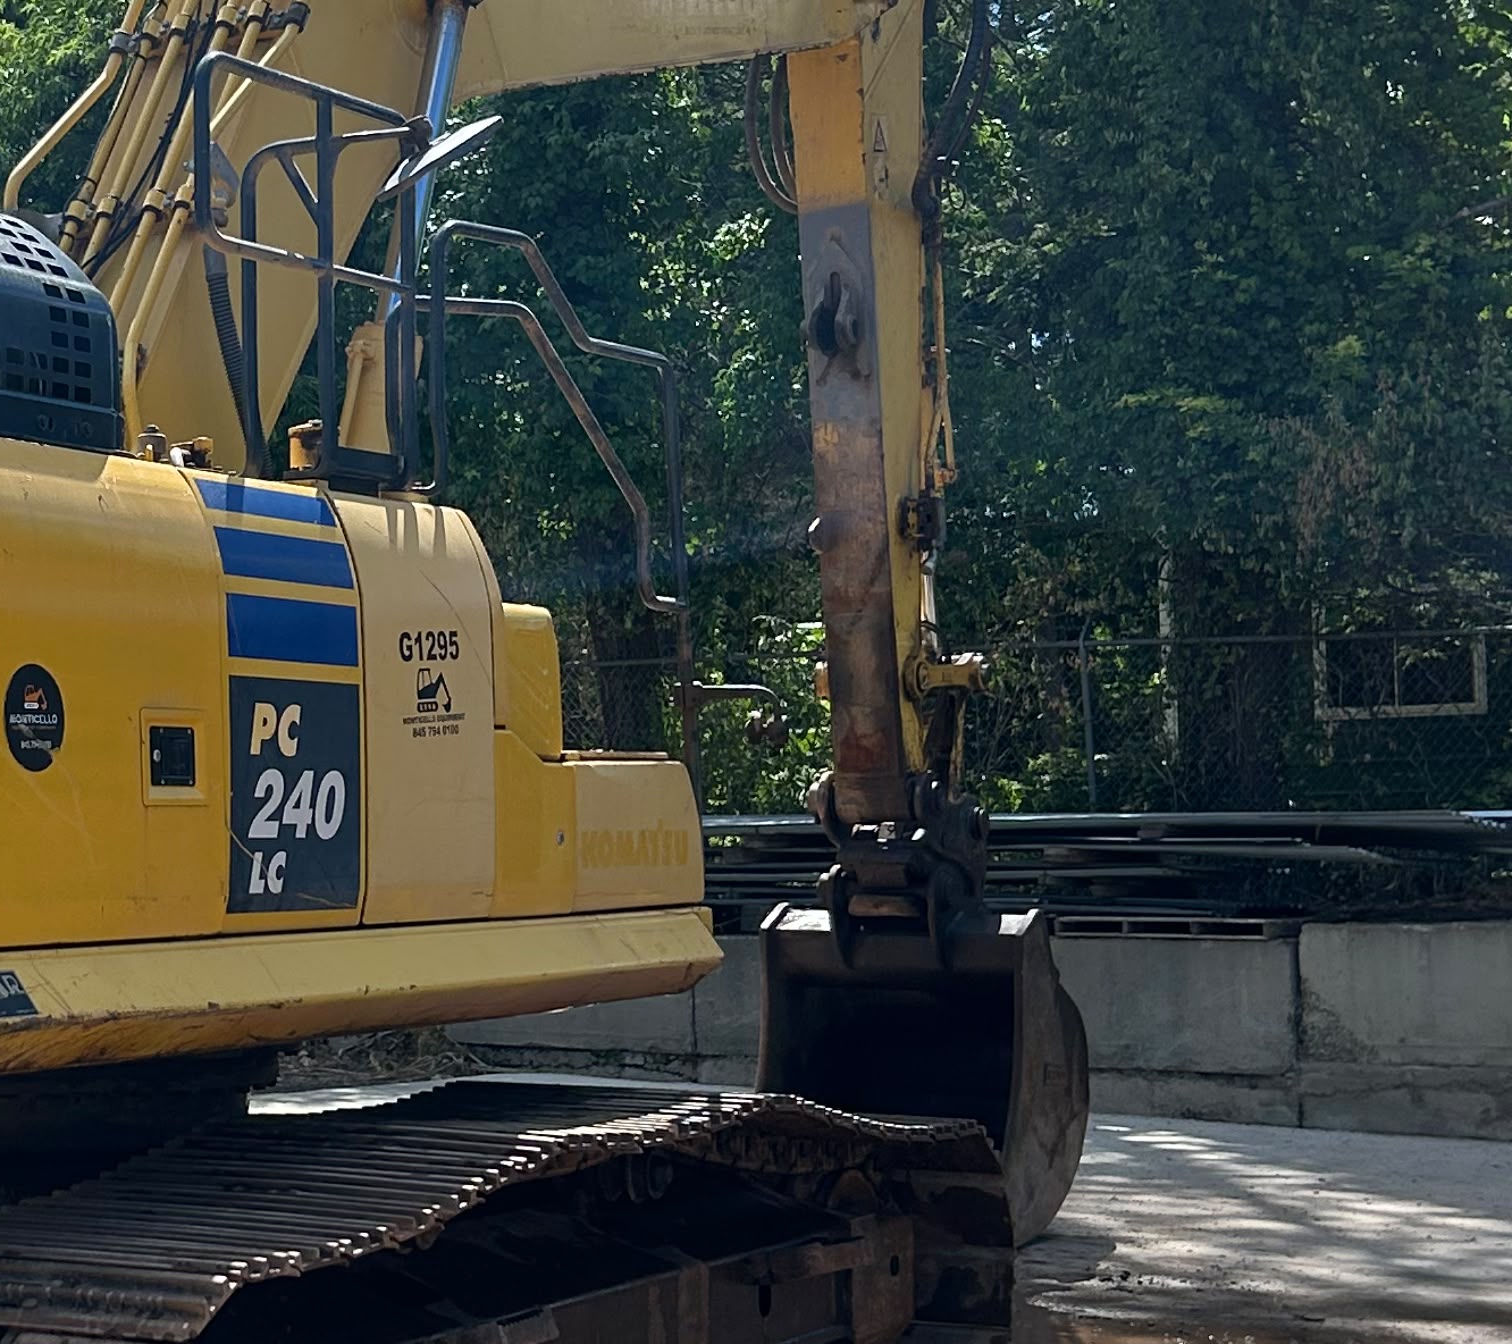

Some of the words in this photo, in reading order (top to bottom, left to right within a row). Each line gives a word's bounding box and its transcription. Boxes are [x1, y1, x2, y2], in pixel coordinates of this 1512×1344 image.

[399, 630, 460, 662] G1295
[249, 702, 302, 757] PC
[248, 768, 346, 840] 240
[249, 851, 286, 895] LC
